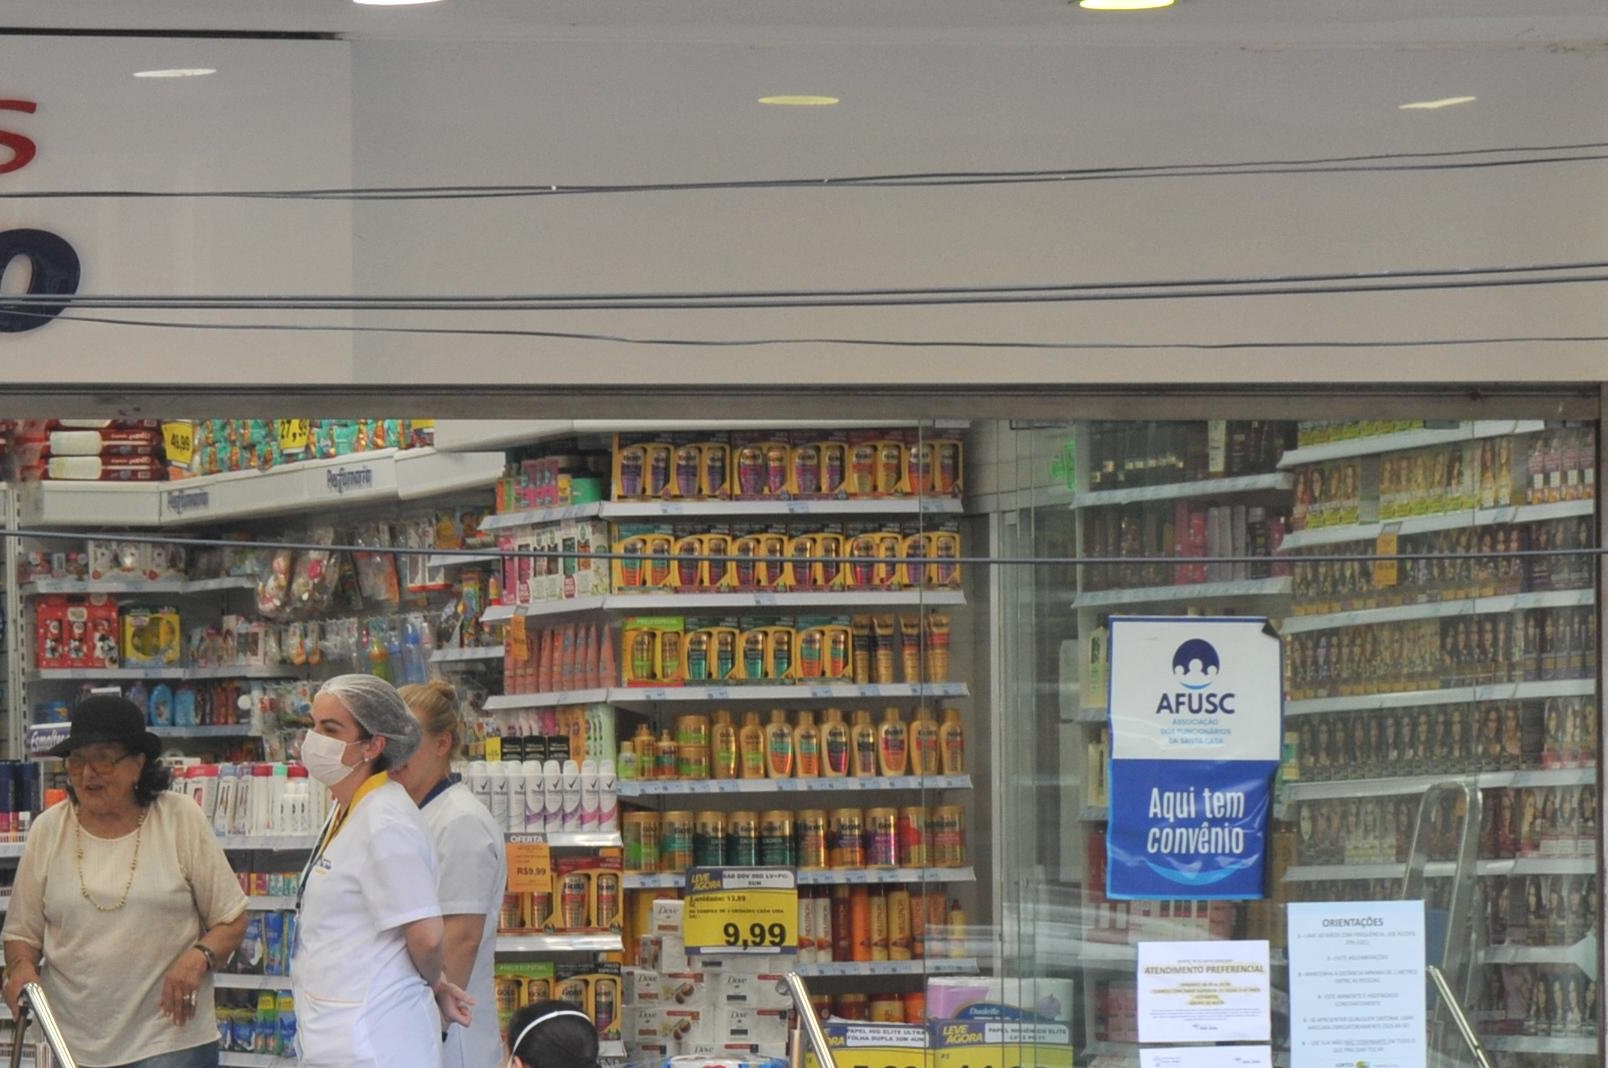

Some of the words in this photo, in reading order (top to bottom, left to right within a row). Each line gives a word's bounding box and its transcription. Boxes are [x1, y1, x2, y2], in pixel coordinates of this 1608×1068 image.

[1155, 693, 1236, 714] AFUSC
[1149, 786, 1196, 824] Aqui
[1203, 787, 1245, 818] tem
[1146, 822, 1245, 855] convênio
[694, 881, 722, 890] AGORA
[1322, 917, 1384, 929] ORIENTAÇÕES
[723, 922, 787, 950] 9,99
[1144, 965, 1204, 975] ATENDIMENTO
[1206, 963, 1265, 974] PREFERENCIAL
[943, 1025, 968, 1035] LEVE
[945, 1034, 984, 1045] AGORA
